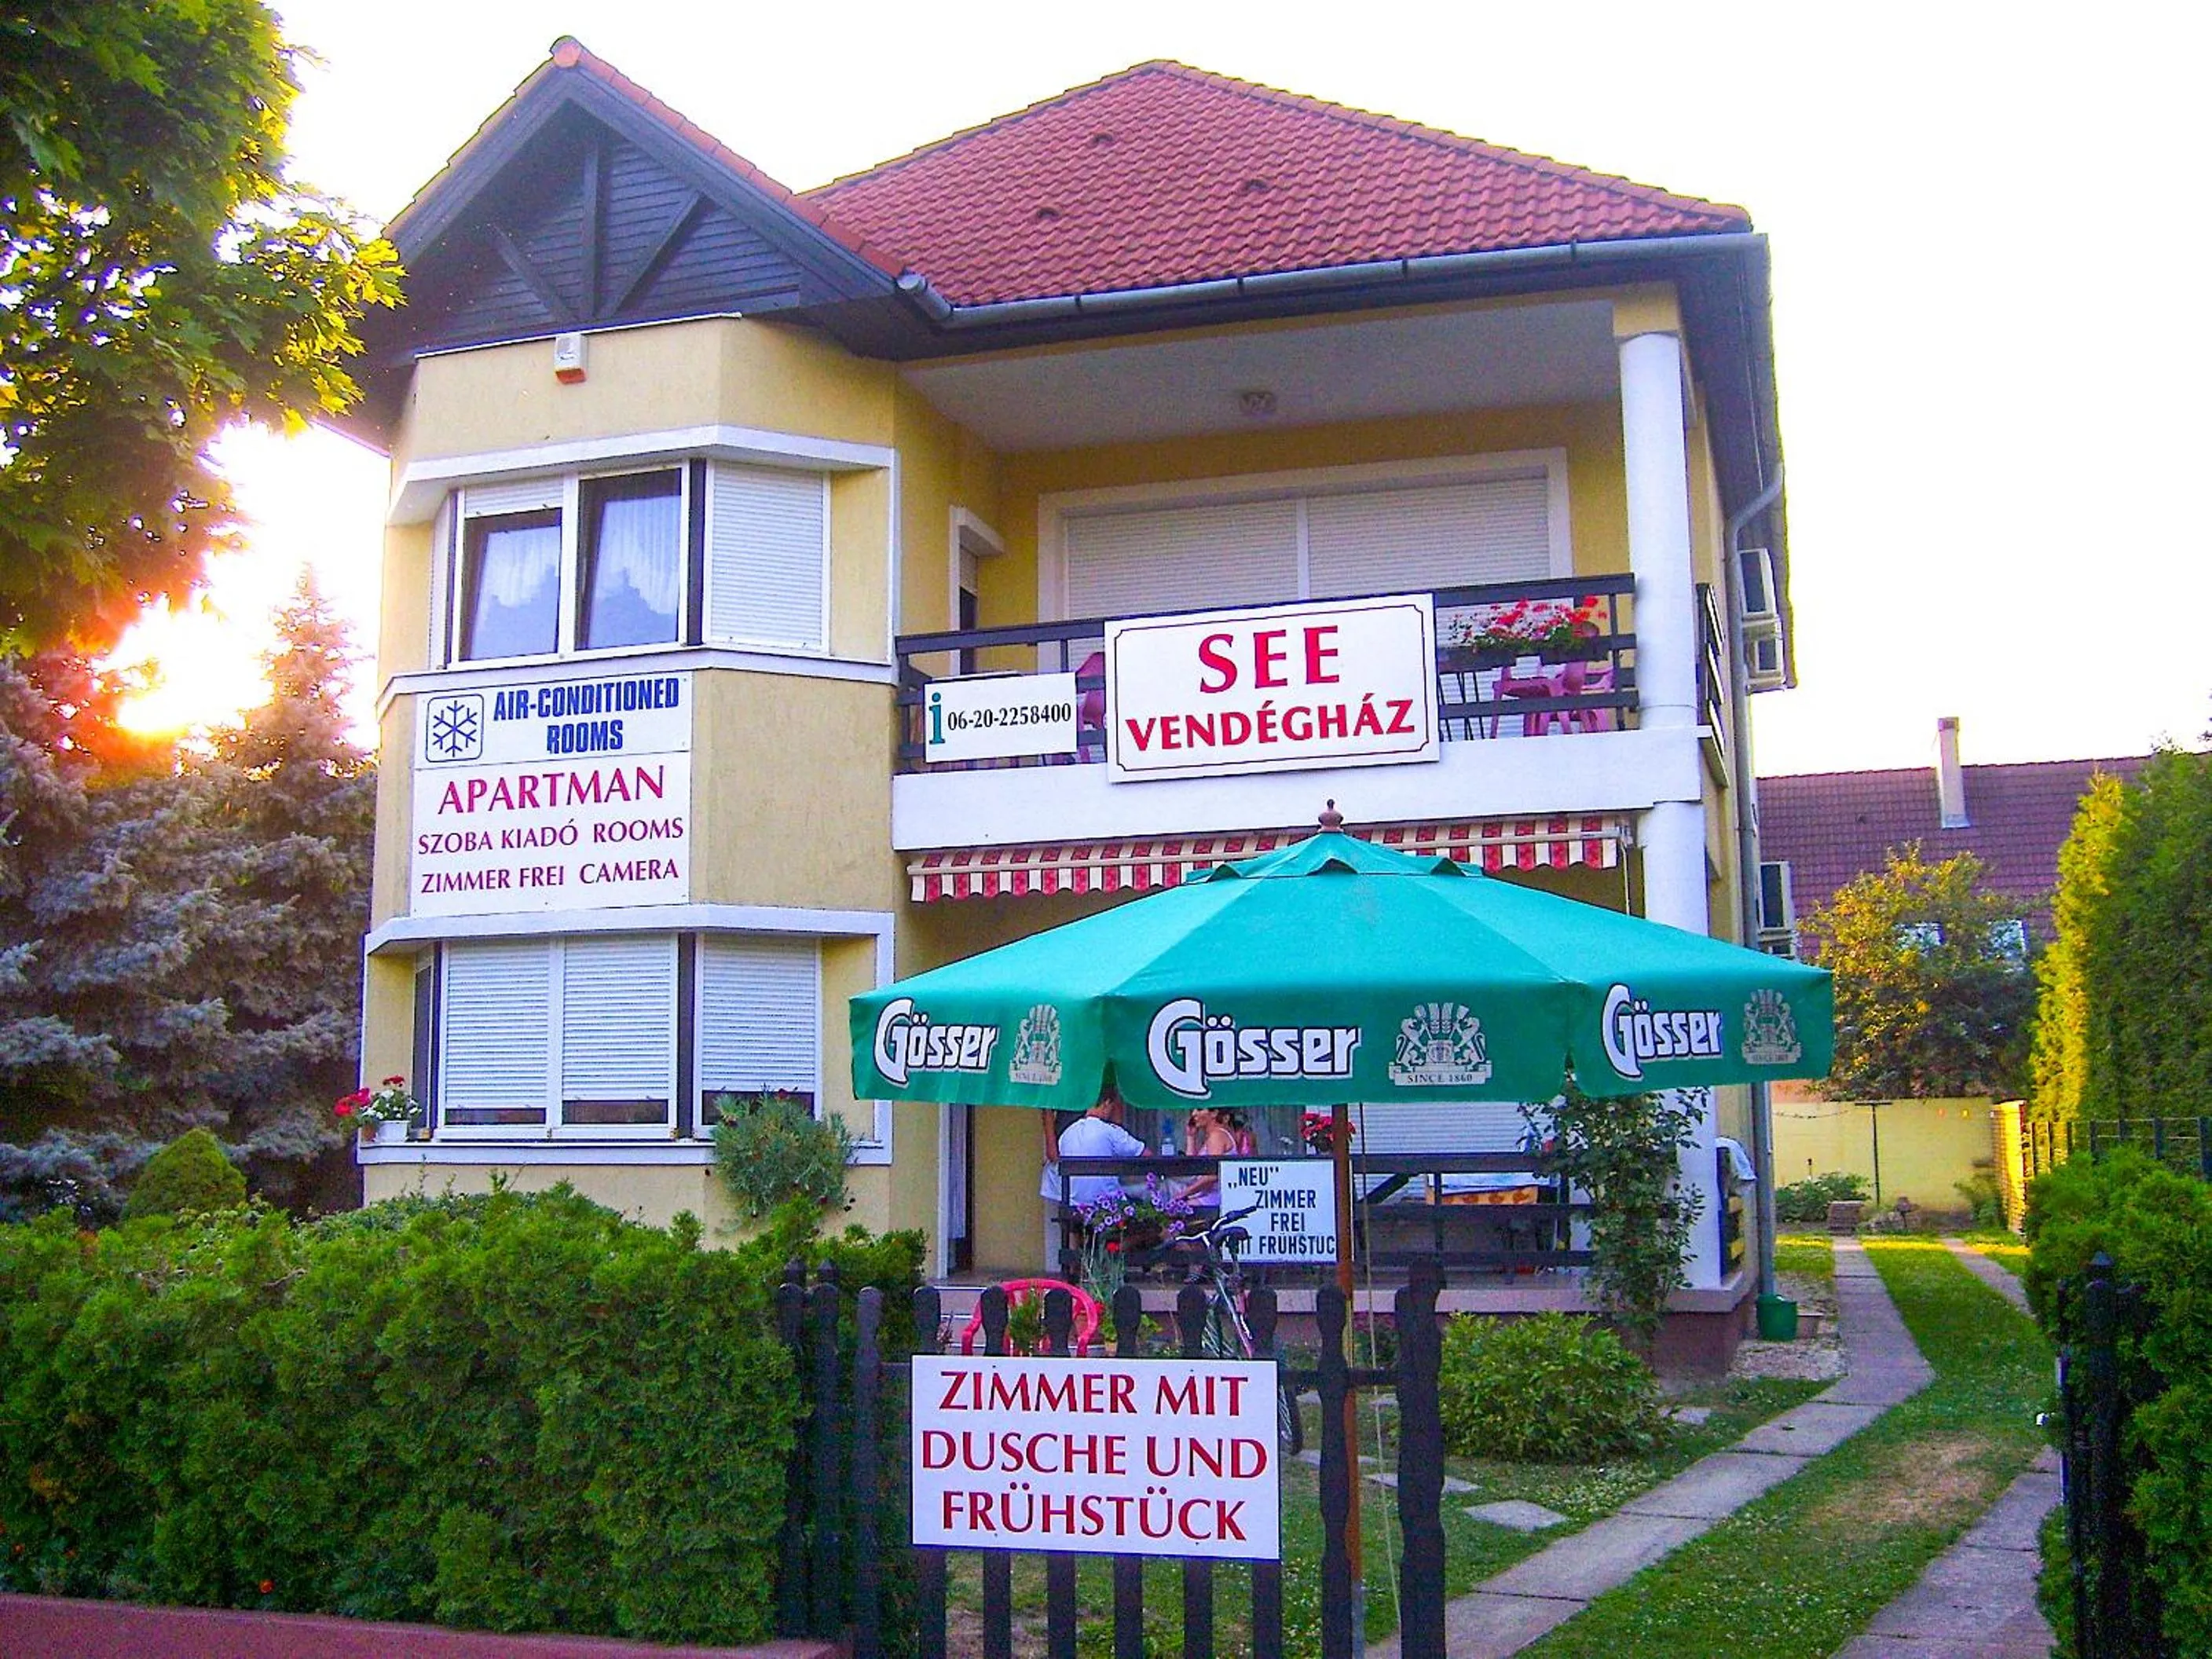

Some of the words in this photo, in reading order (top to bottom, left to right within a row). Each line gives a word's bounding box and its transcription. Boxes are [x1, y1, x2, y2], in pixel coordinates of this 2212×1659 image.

[1199, 625, 1340, 694] SEE
[493, 677, 679, 721] AIR-CONDITIONED
[947, 703, 1071, 731] 06-20-2258400
[546, 720, 624, 754] ROOMS
[1125, 693, 1415, 752] VENDÉGHÁZ
[438, 764, 665, 815] APARTMAN
[418, 831, 493, 855] SZOBA
[500, 819, 578, 849] KIADÓ
[593, 818, 684, 843] ROOMS
[420, 869, 511, 894] ZIMMER
[519, 866, 565, 888] FREI
[579, 859, 679, 884] CAMERA
[873, 997, 999, 1089] Gösser
[1146, 997, 1361, 1098] Gösser
[1602, 983, 1723, 1080] Gösser
[1255, 1189, 1317, 1209] ZIMMER
[1259, 1232, 1336, 1254] FRÜHSTUC
[1271, 1212, 1306, 1232] FREI
[940, 1371, 1137, 1414] ZIMMER
[1156, 1374, 1249, 1416] MIT
[921, 1430, 1126, 1475] DUSCHE
[1147, 1435, 1269, 1479] UND
[942, 1481, 1247, 1541] FRÜHSTÜCK
